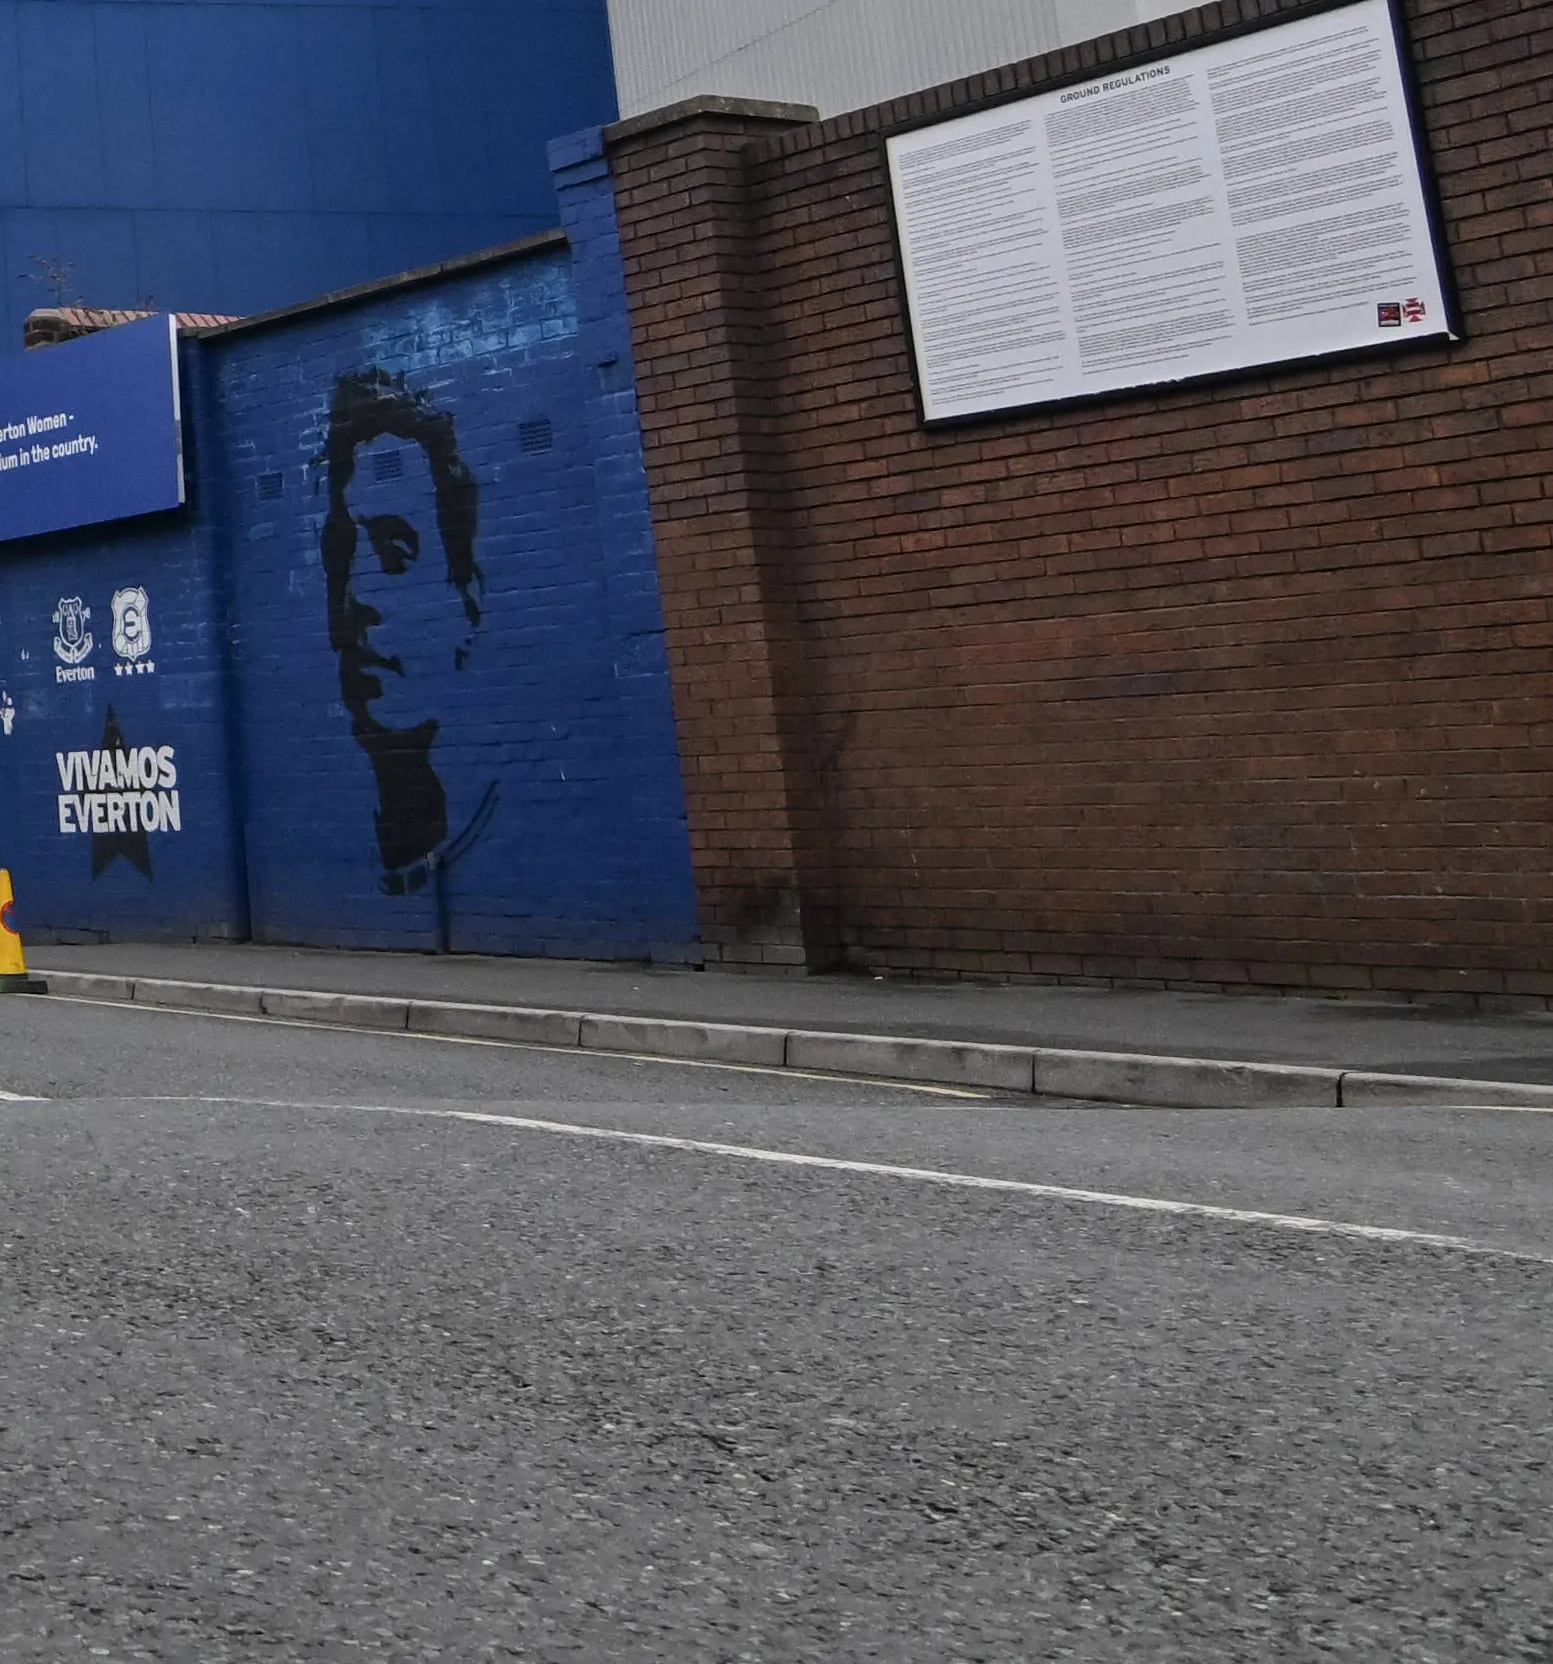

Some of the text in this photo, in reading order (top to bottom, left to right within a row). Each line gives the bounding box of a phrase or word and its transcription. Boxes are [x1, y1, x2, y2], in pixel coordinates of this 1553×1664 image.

[1060, 65, 1171, 104] GROUND REGULATIONS
[26, 412, 67, 435] Women
[19, 448, 30, 466] in
[31, 445, 50, 463] the
[52, 435, 98, 457] country.
[56, 666, 95, 683] Everton
[56, 745, 177, 791] VIVAMOS
[58, 790, 181, 833] EVERTON
